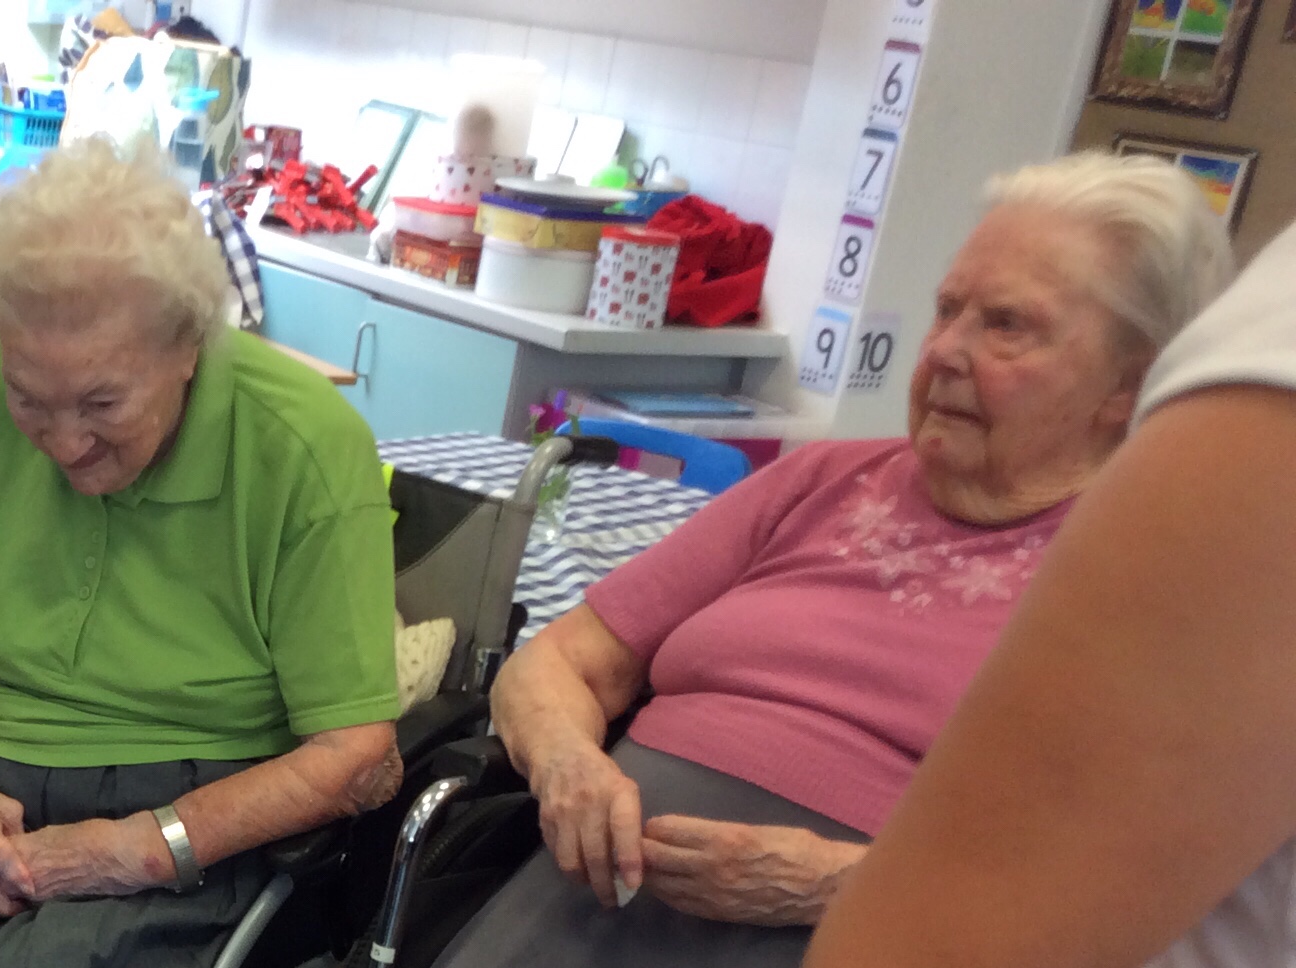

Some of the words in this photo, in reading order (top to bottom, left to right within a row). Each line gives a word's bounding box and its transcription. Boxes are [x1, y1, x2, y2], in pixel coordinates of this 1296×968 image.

[882, 62, 903, 105] 6
[860, 149, 884, 191] 7
[839, 235, 862, 277] 8
[817, 327, 835, 369] 9
[858, 331, 893, 373] 10
